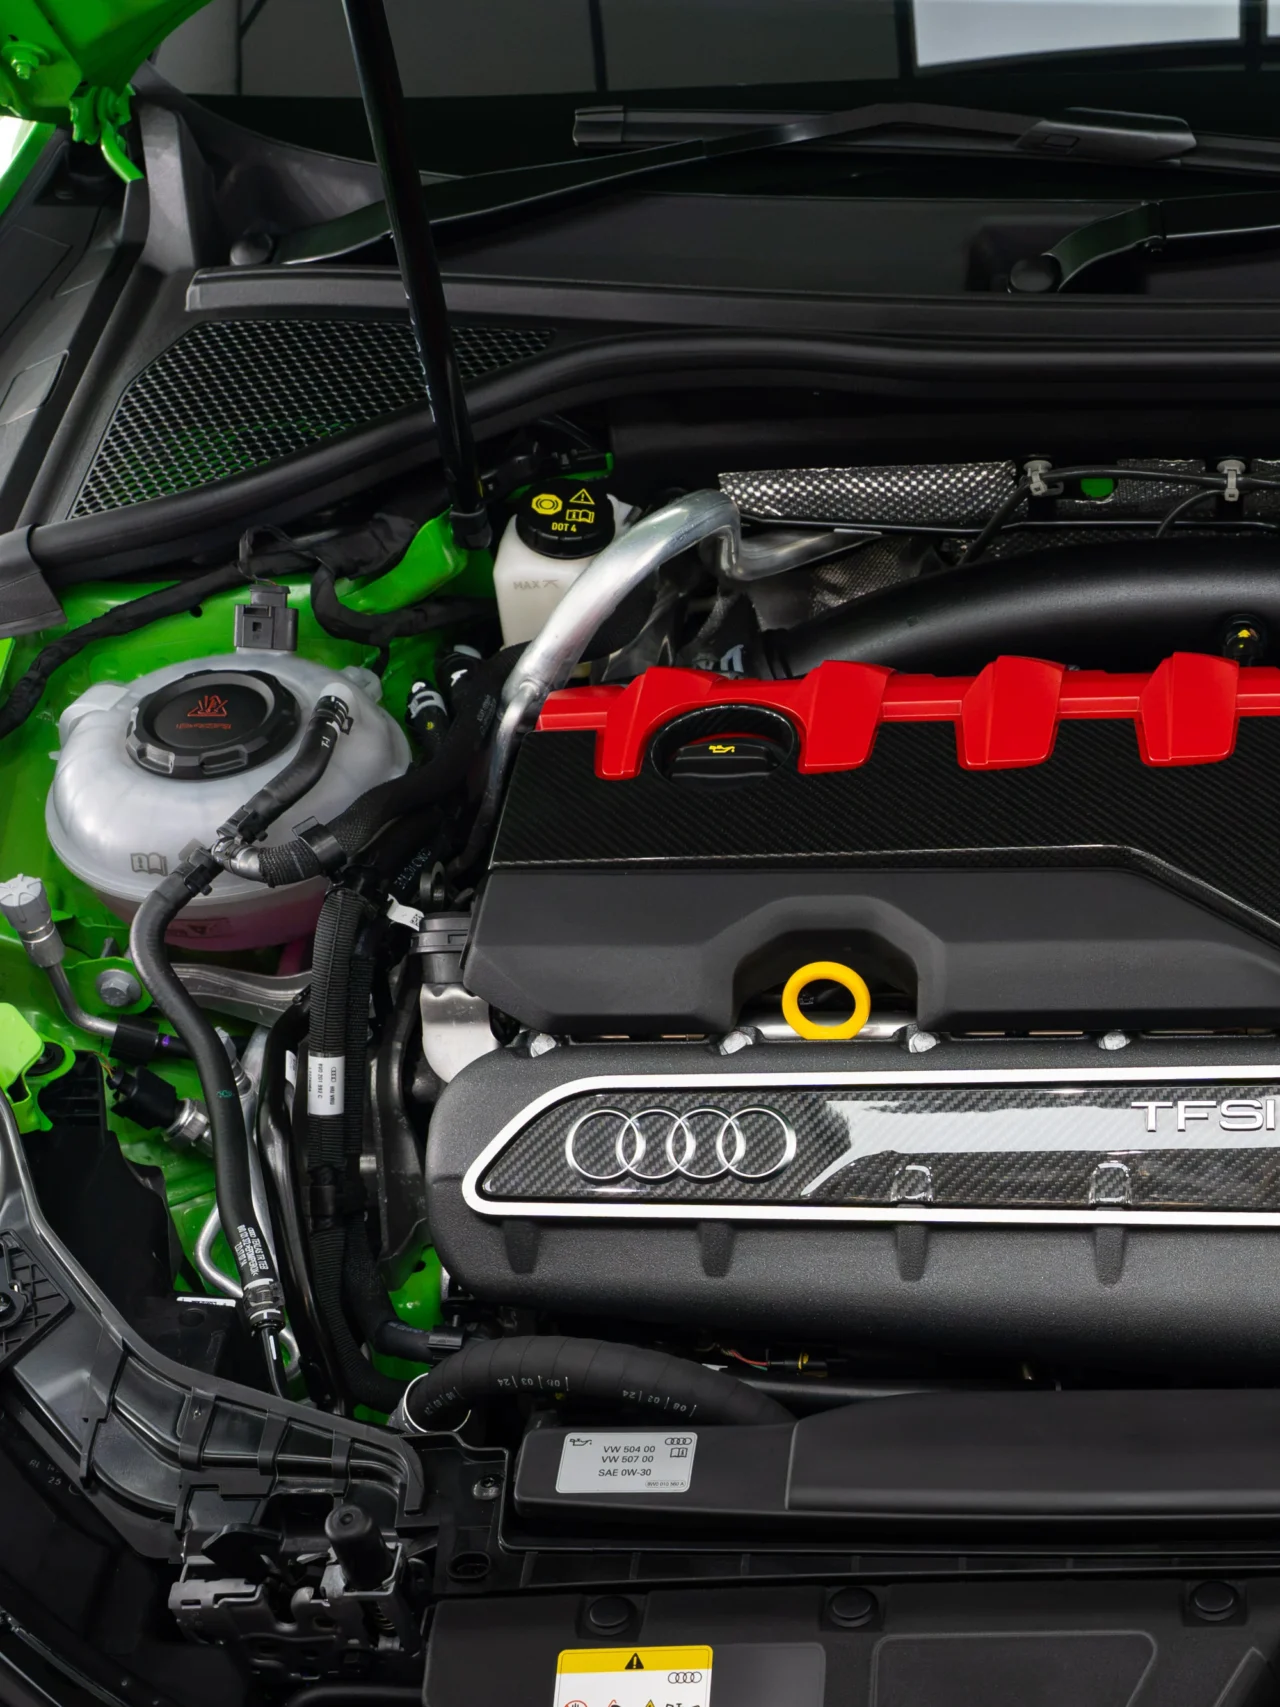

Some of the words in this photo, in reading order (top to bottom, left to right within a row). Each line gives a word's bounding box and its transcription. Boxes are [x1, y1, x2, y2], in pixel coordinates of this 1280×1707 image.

[552, 522, 569, 532] DOT
[570, 524, 577, 532] 4
[513, 581, 540, 590] MAX
[1130, 1099, 1276, 1132] TFSI
[498, 1378, 510, 1387] 24
[521, 1378, 534, 1386] 03
[622, 1389, 636, 1399] 24
[673, 1402, 687, 1412] 08
[598, 1468, 618, 1476] SAE
[621, 1468, 652, 1476] 0W-30
